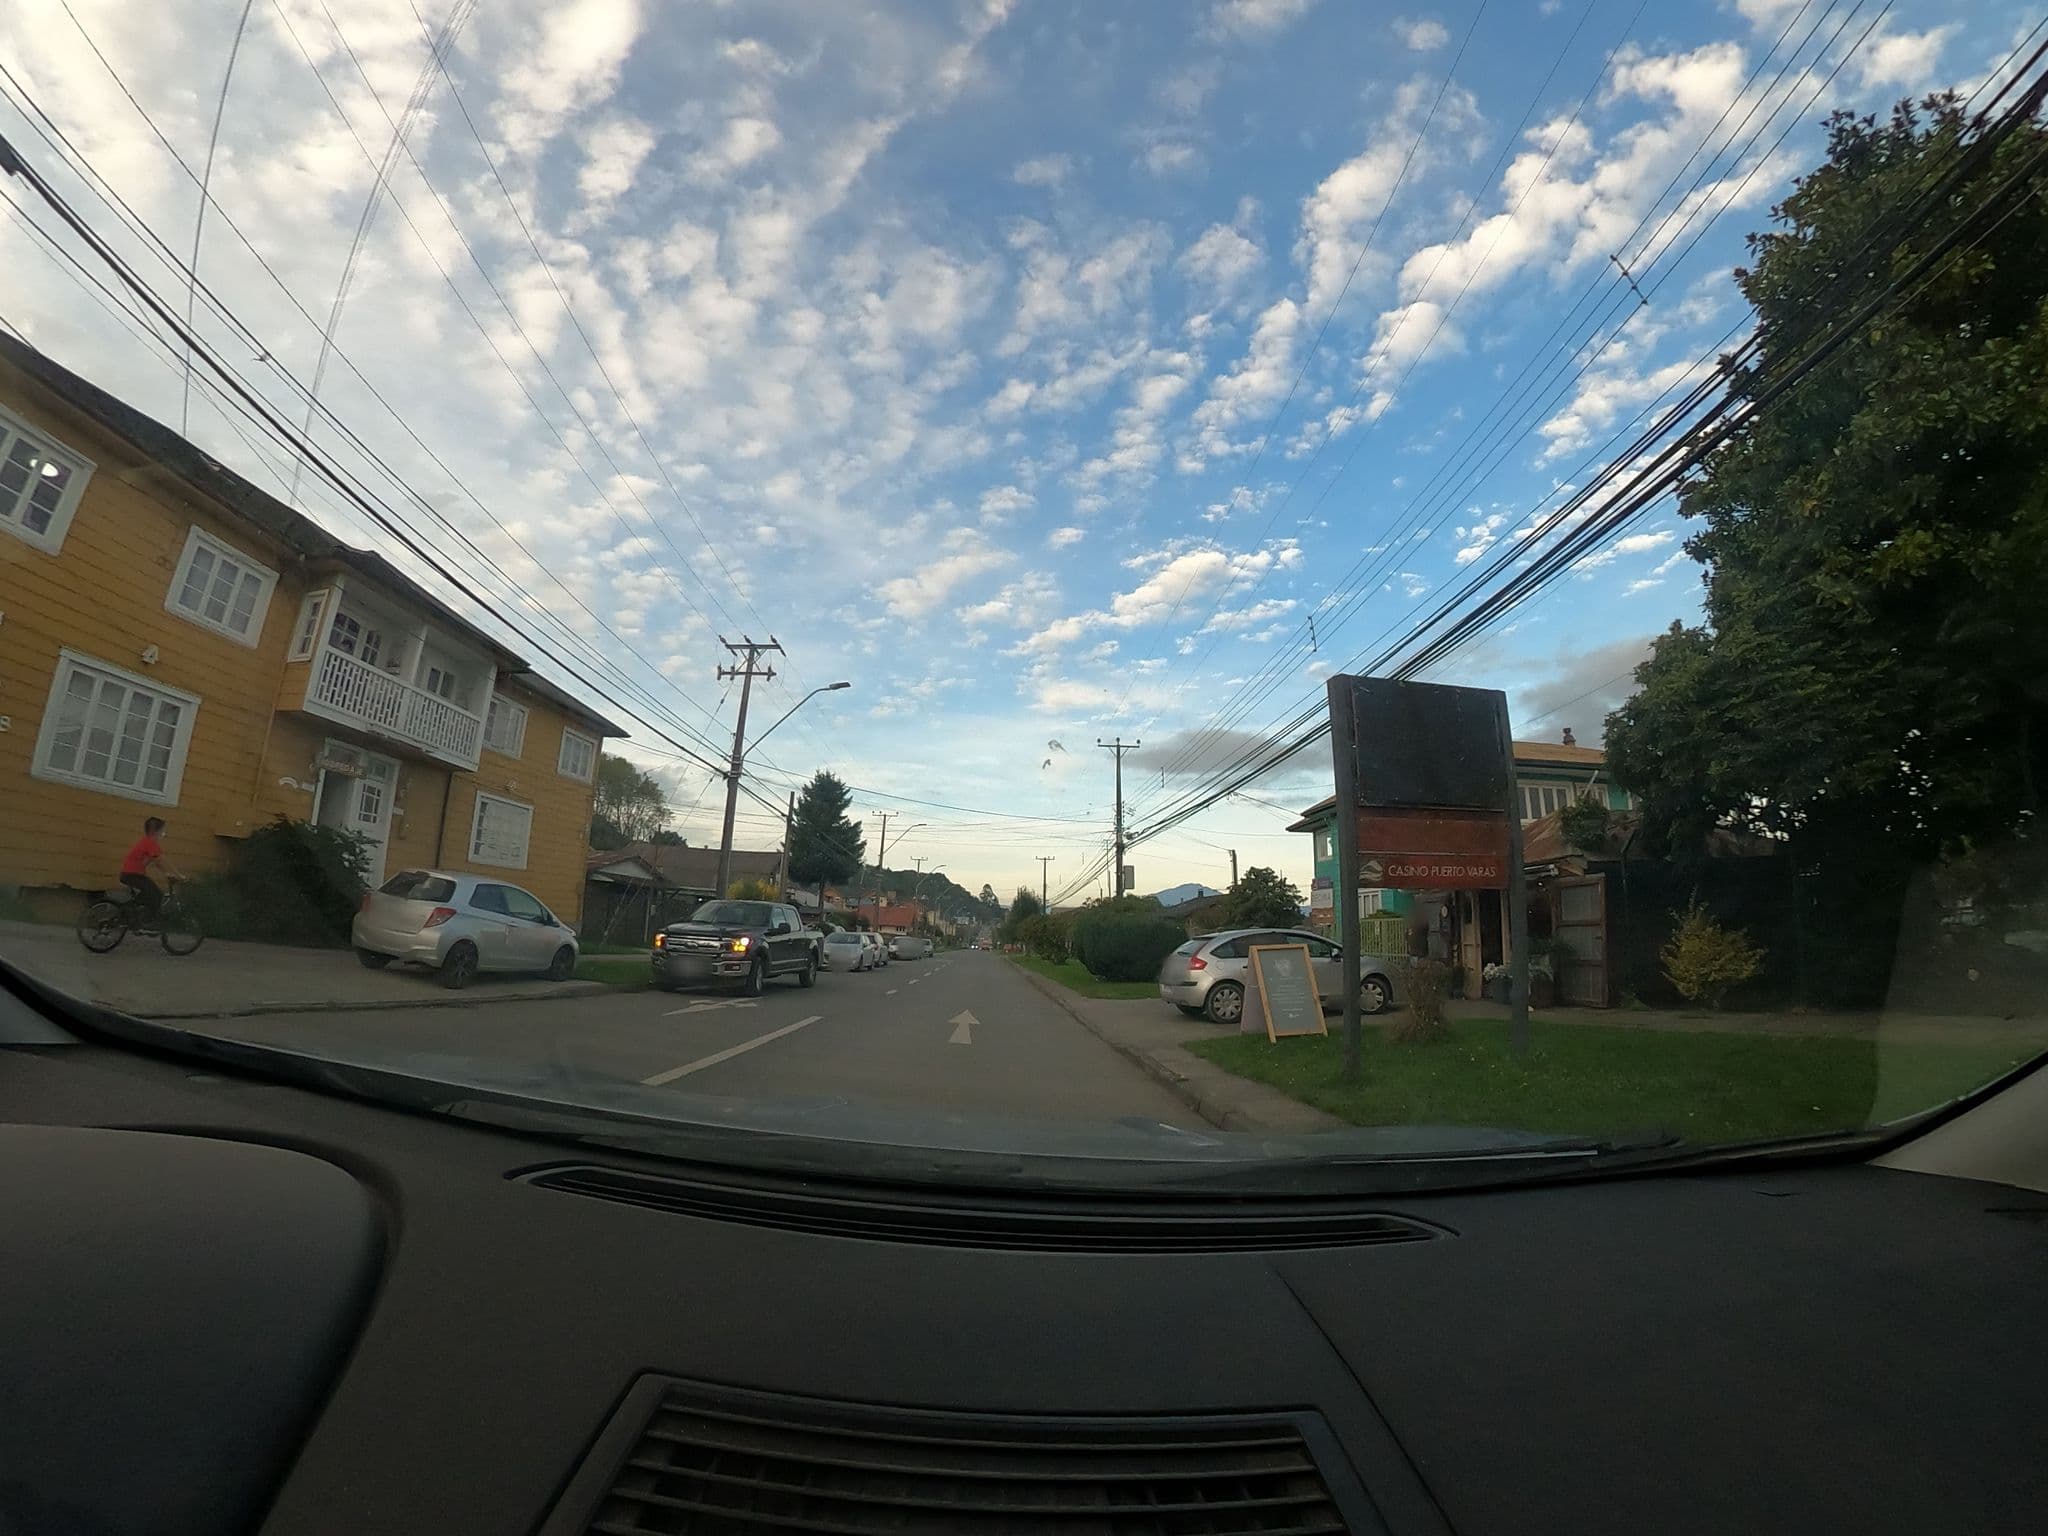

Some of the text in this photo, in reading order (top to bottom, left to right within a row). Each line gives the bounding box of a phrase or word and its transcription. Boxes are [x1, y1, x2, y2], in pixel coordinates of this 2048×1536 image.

[1388, 865, 1497, 878] CASINO PUERTO VARAS
